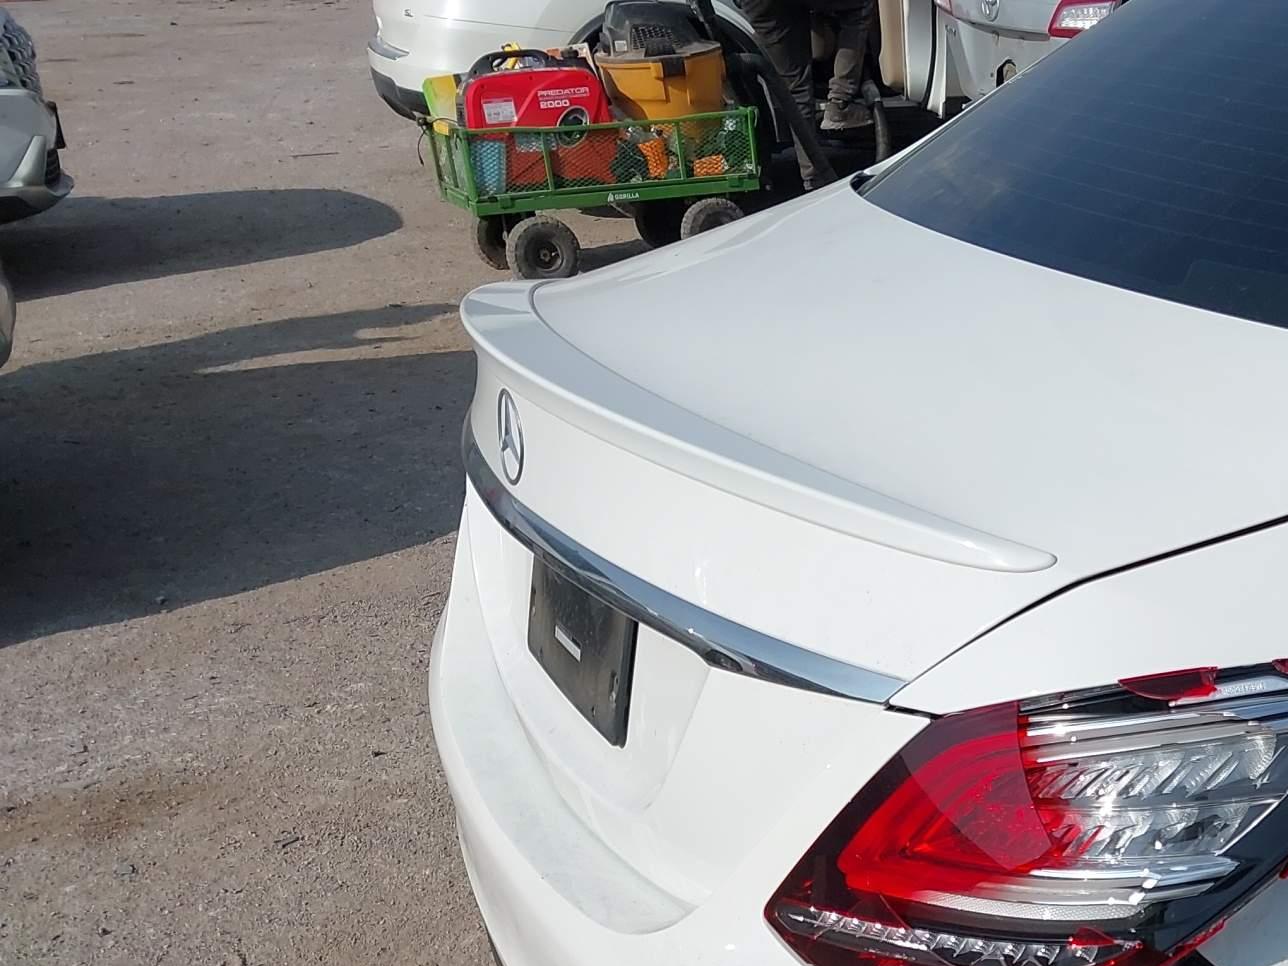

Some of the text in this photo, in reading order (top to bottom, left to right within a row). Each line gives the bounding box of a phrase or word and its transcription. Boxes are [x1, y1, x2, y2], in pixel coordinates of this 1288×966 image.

[537, 87, 589, 97] PREDATOR
[539, 99, 570, 109] 2000
[614, 192, 640, 200] GORILLA
